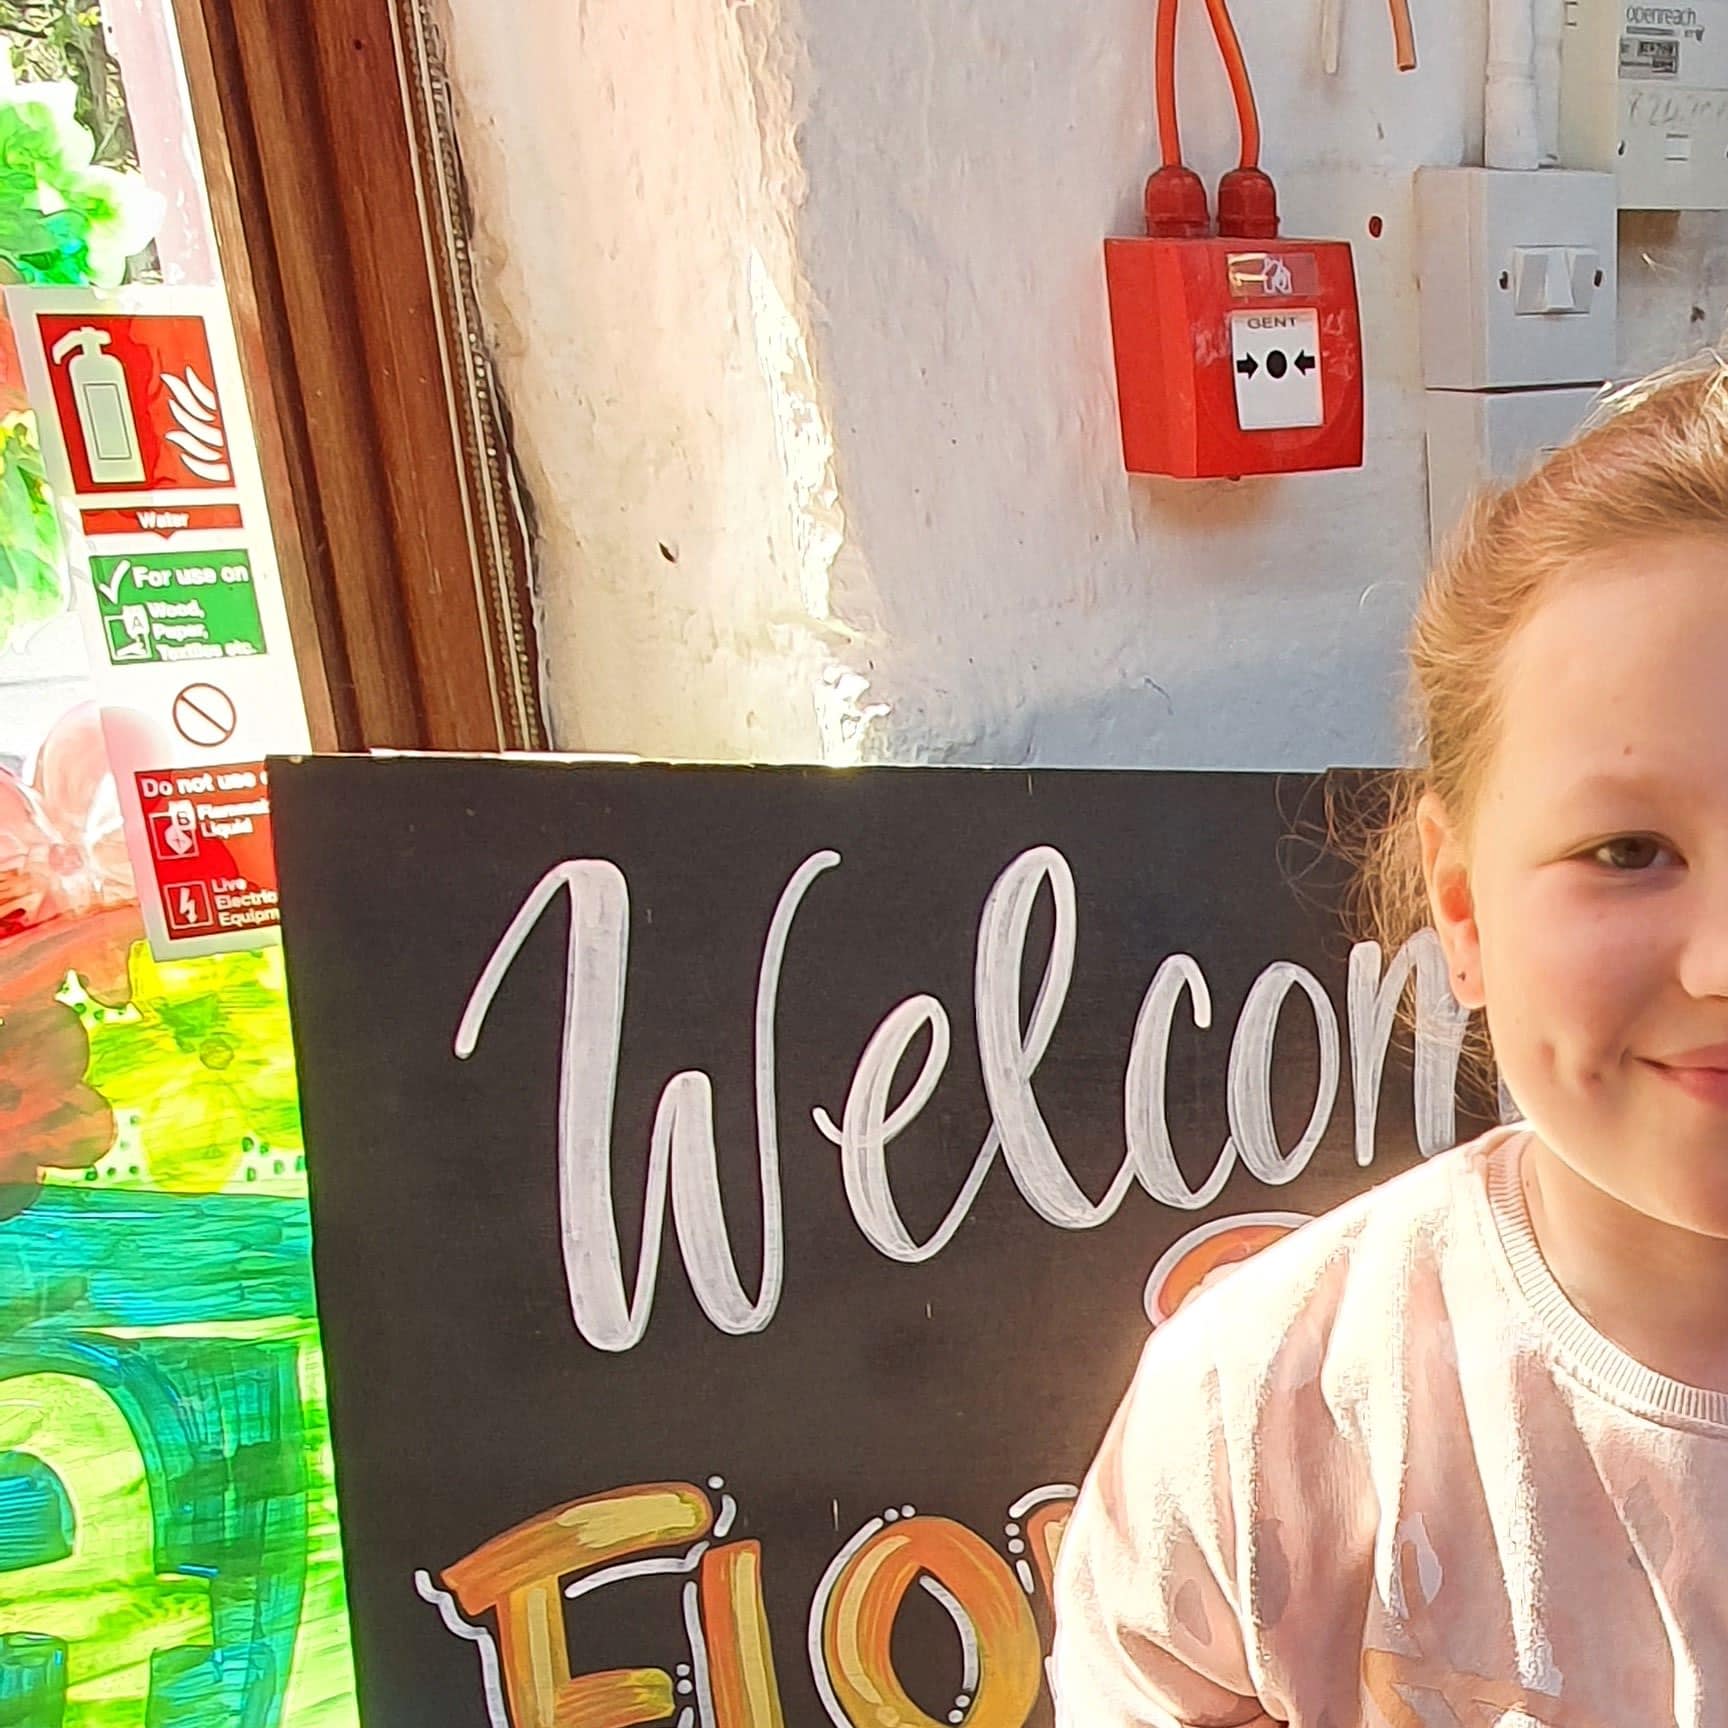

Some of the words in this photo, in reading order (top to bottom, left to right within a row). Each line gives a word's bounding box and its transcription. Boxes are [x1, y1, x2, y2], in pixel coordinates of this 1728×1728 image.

[1625, 6, 1697, 26] openreach
[1247, 315, 1298, 330] GENT
[137, 511, 190, 530] Water
[132, 565, 172, 589] For
[174, 567, 217, 587] use
[220, 565, 250, 584] on
[141, 778, 174, 798] Do
[176, 772, 215, 795] not
[217, 771, 256, 790] use
[201, 817, 253, 839] Liquid
[211, 877, 247, 893] Live
